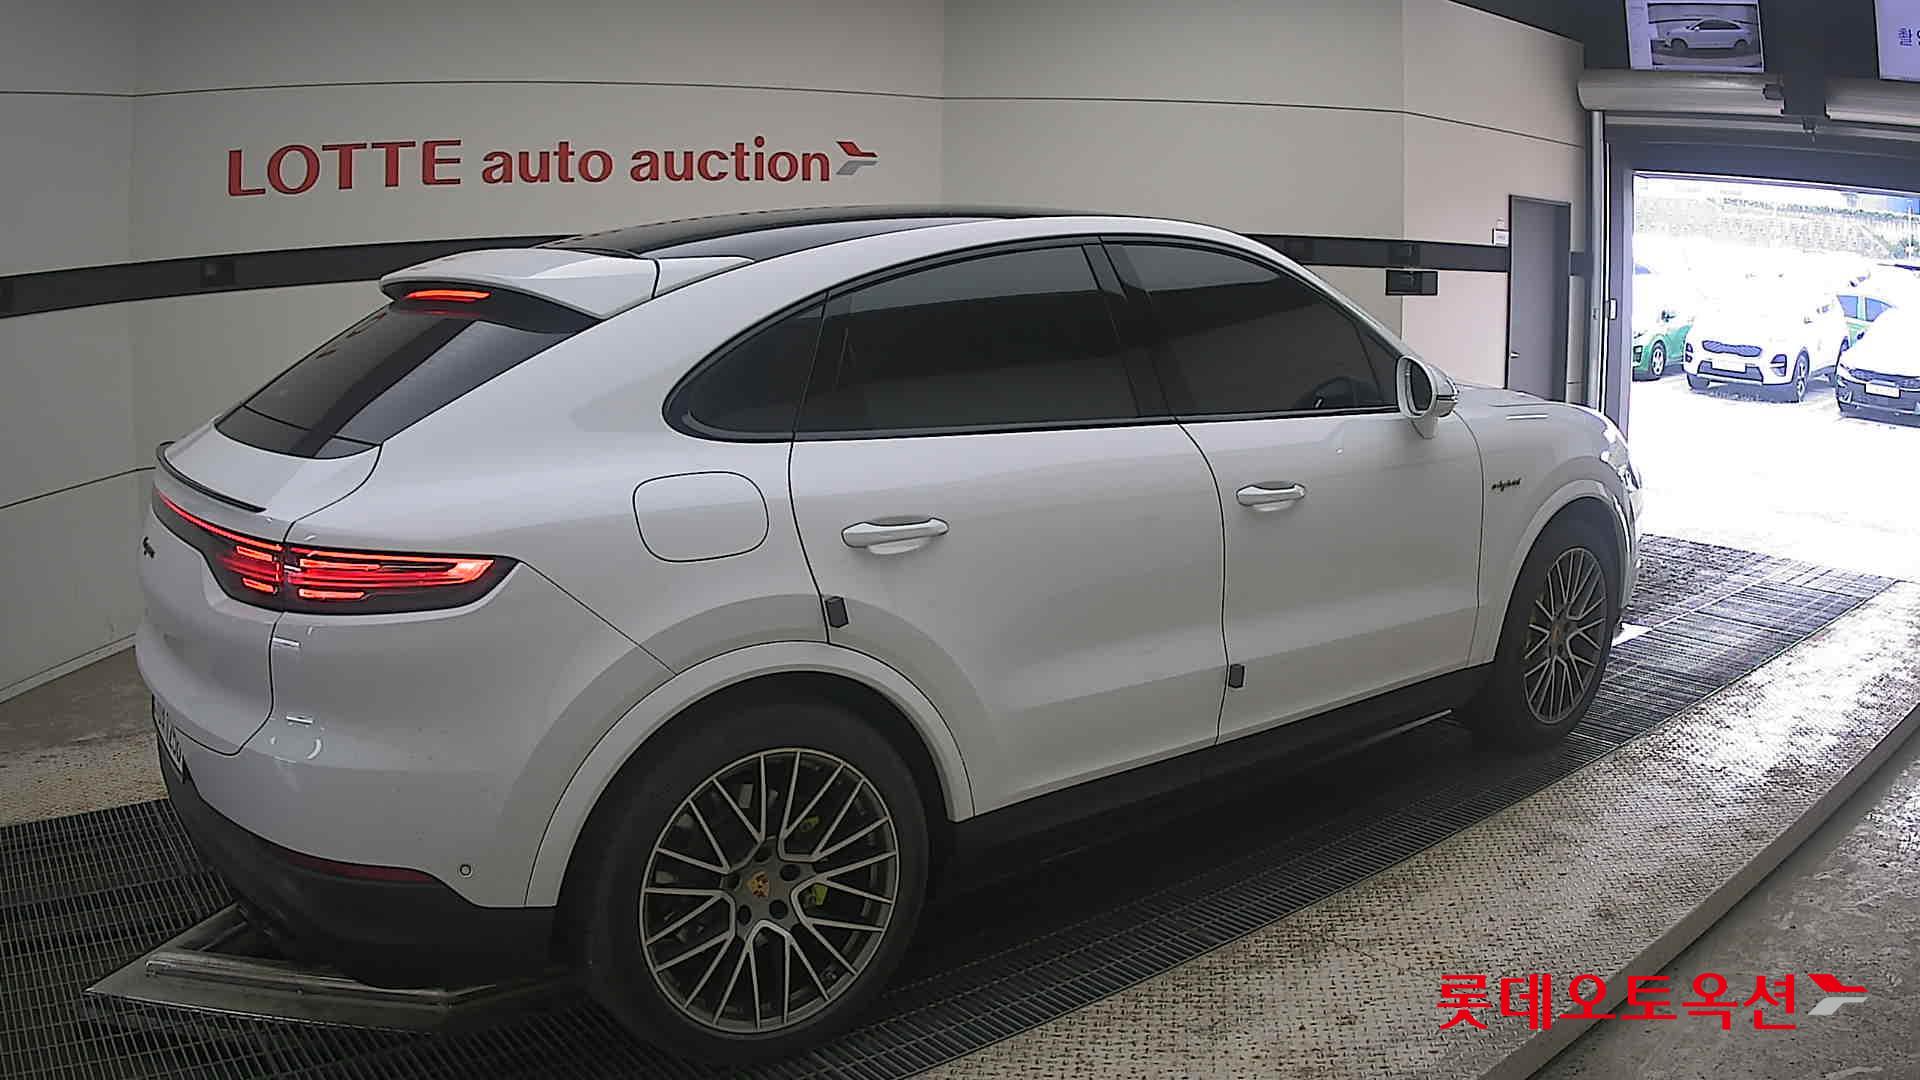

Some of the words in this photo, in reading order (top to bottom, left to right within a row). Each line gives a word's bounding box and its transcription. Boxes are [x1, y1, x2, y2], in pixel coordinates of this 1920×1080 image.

[228, 140, 462, 197] LOTTE
[481, 142, 614, 183] auto
[629, 137, 831, 182] auction
